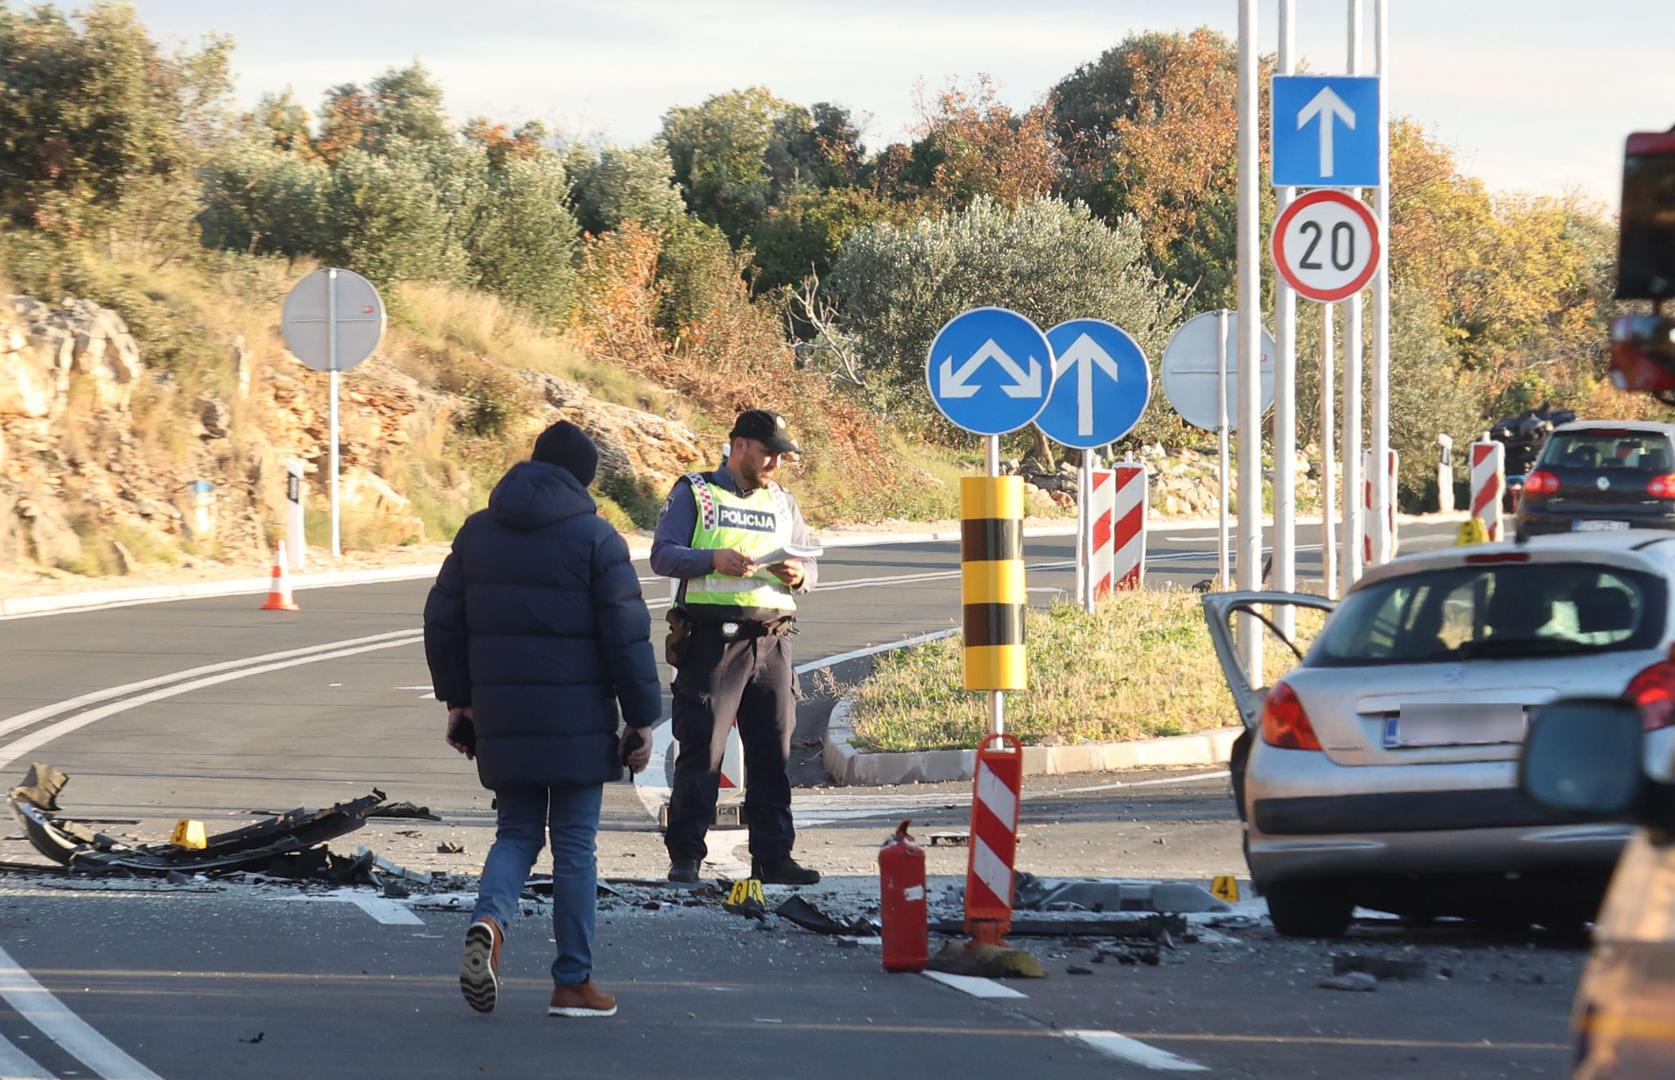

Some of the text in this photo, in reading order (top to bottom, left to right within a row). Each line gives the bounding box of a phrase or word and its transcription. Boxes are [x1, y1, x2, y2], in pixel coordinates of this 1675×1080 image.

[1299, 220, 1355, 271] 20
[720, 509, 775, 529] POLICIJA
[175, 821, 186, 842] 3
[733, 882, 743, 904] 8
[1217, 876, 1229, 899] 4
